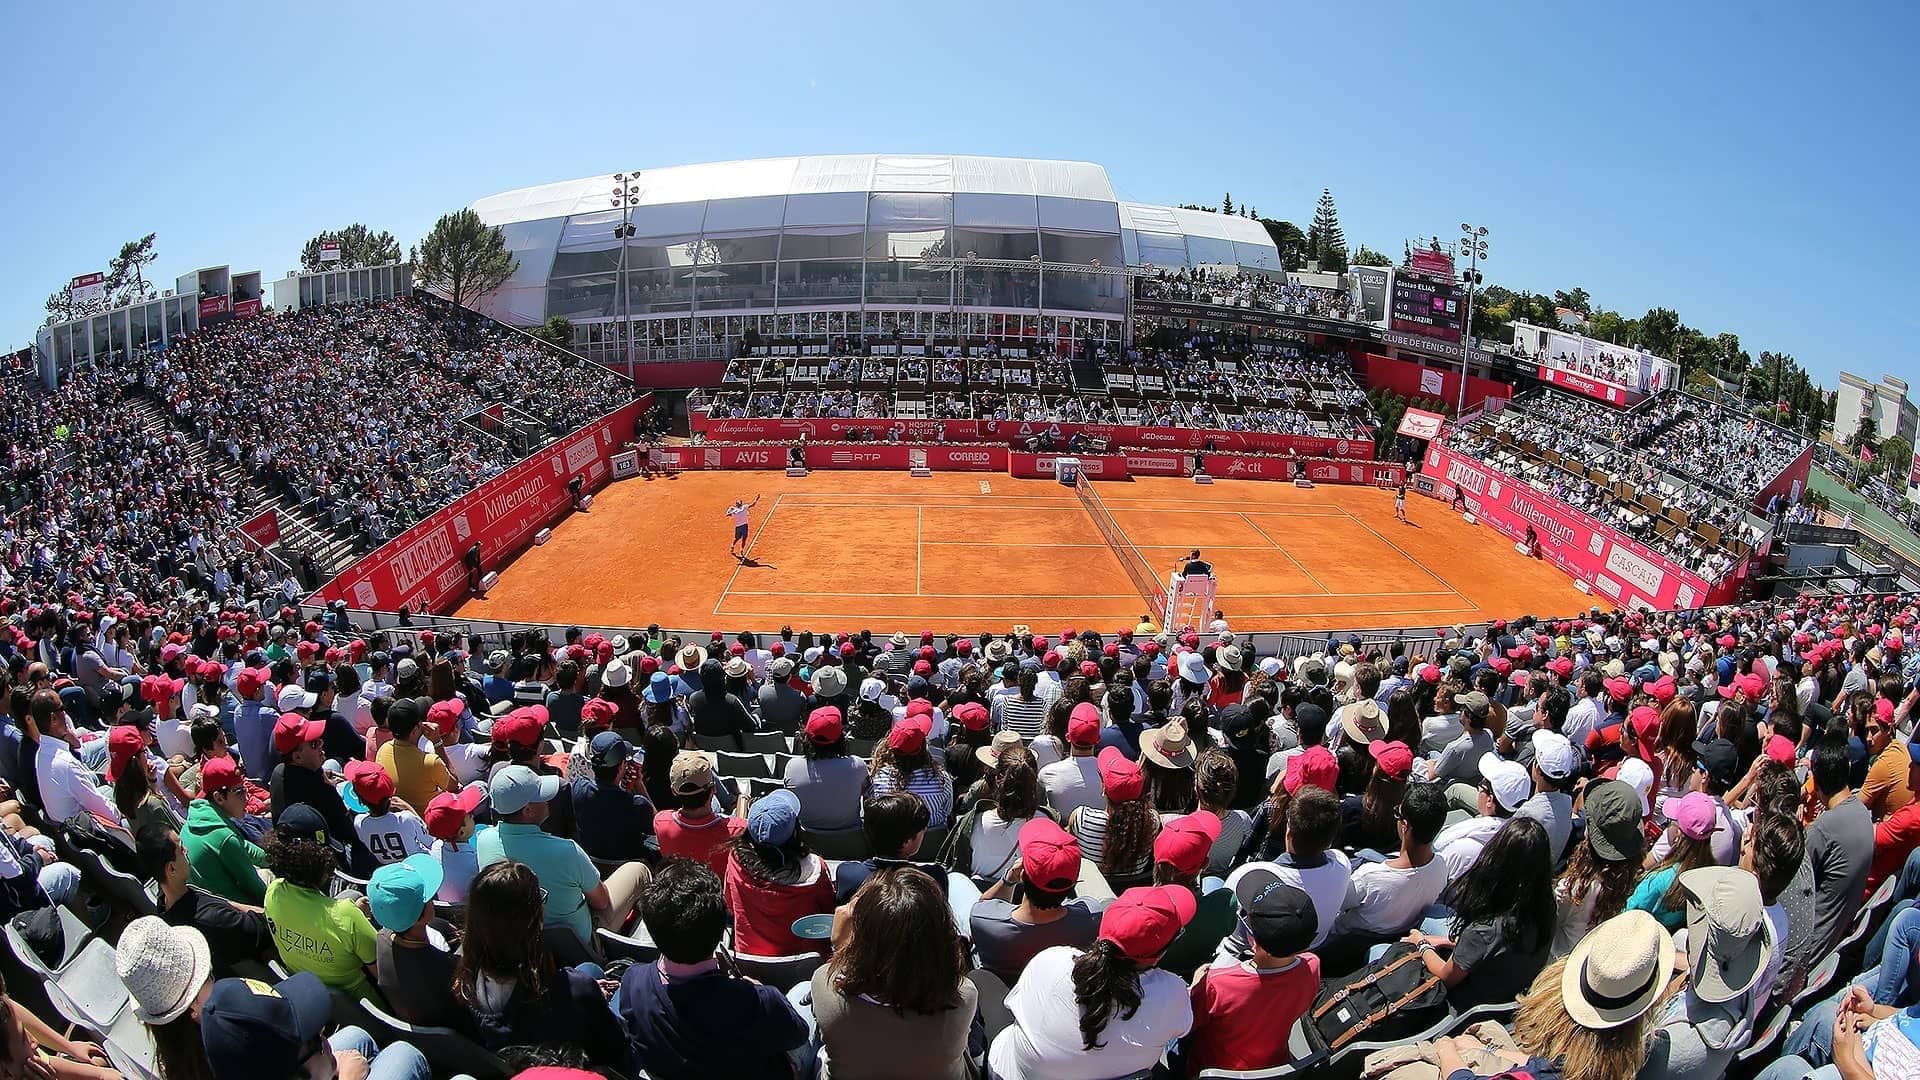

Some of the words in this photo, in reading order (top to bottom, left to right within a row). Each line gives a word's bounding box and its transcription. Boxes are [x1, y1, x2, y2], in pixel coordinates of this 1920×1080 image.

[1383, 333, 1407, 345] CLUBE
[1409, 339, 1420, 347] DE
[1446, 346, 1458, 355] DO
[1459, 349, 1492, 363] ETORIL
[1141, 432, 1176, 441] JCDecaux
[736, 450, 769, 463] AVIS
[854, 453, 881, 461] RTP
[949, 452, 990, 461] CORREIO
[1247, 462, 1263, 473] ctt
[1448, 461, 1485, 496] PLACARD
[482, 475, 545, 524] Millennium
[1510, 491, 1575, 543] Millennium
[391, 527, 453, 593] PLACARD
[1610, 552, 1658, 588] CASCAIS
[369, 832, 405, 861] 49
[279, 926, 333, 956] LEZIRIA
